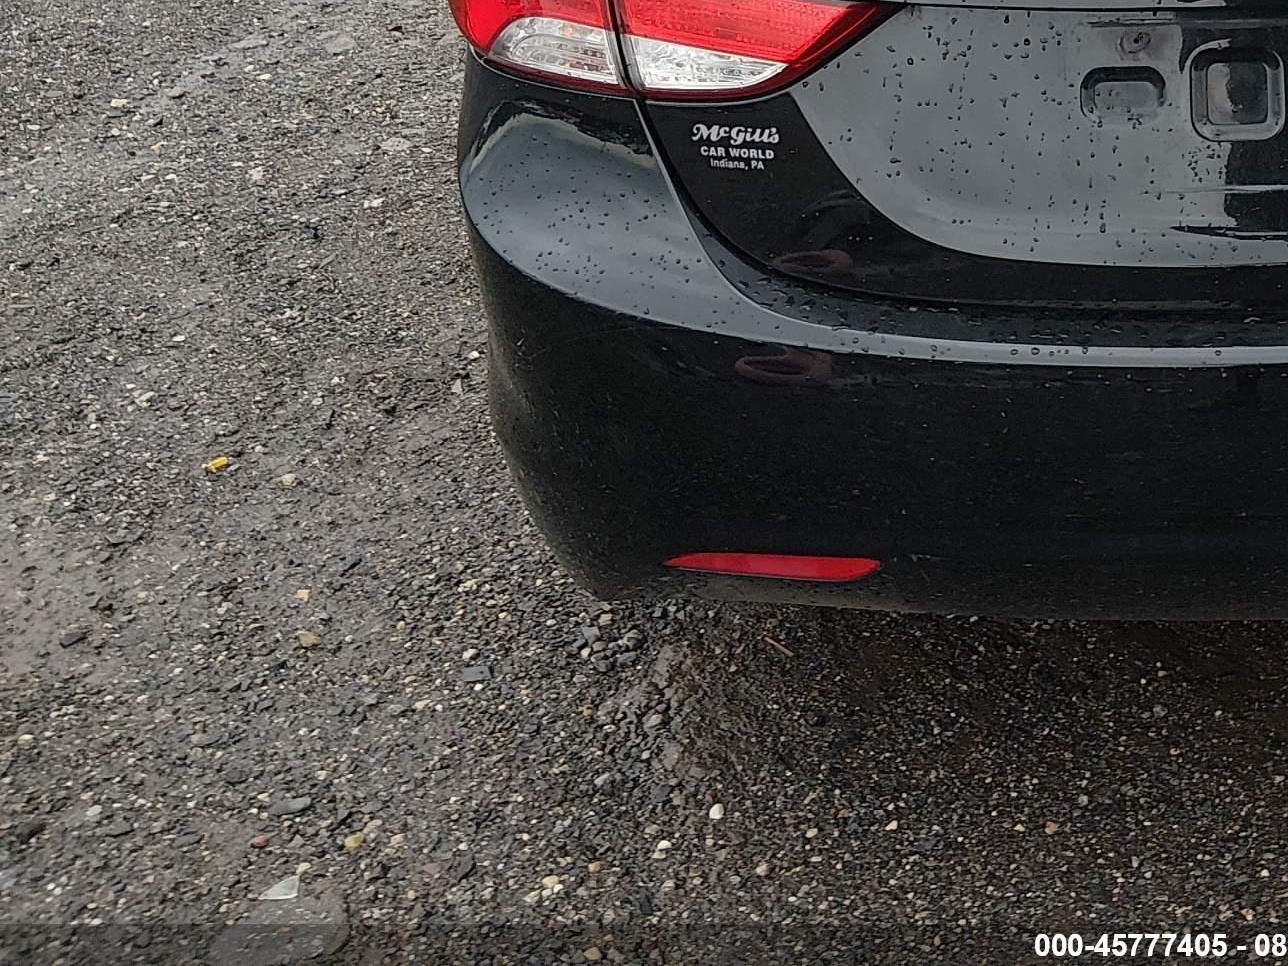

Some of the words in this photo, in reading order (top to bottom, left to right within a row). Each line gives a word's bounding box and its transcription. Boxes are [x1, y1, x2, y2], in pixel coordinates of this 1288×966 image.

[691, 123, 780, 145] McGill's
[700, 146, 726, 157] CAR
[729, 147, 775, 159] WORLD
[710, 158, 749, 170] Indiana,
[751, 160, 765, 170] PA
